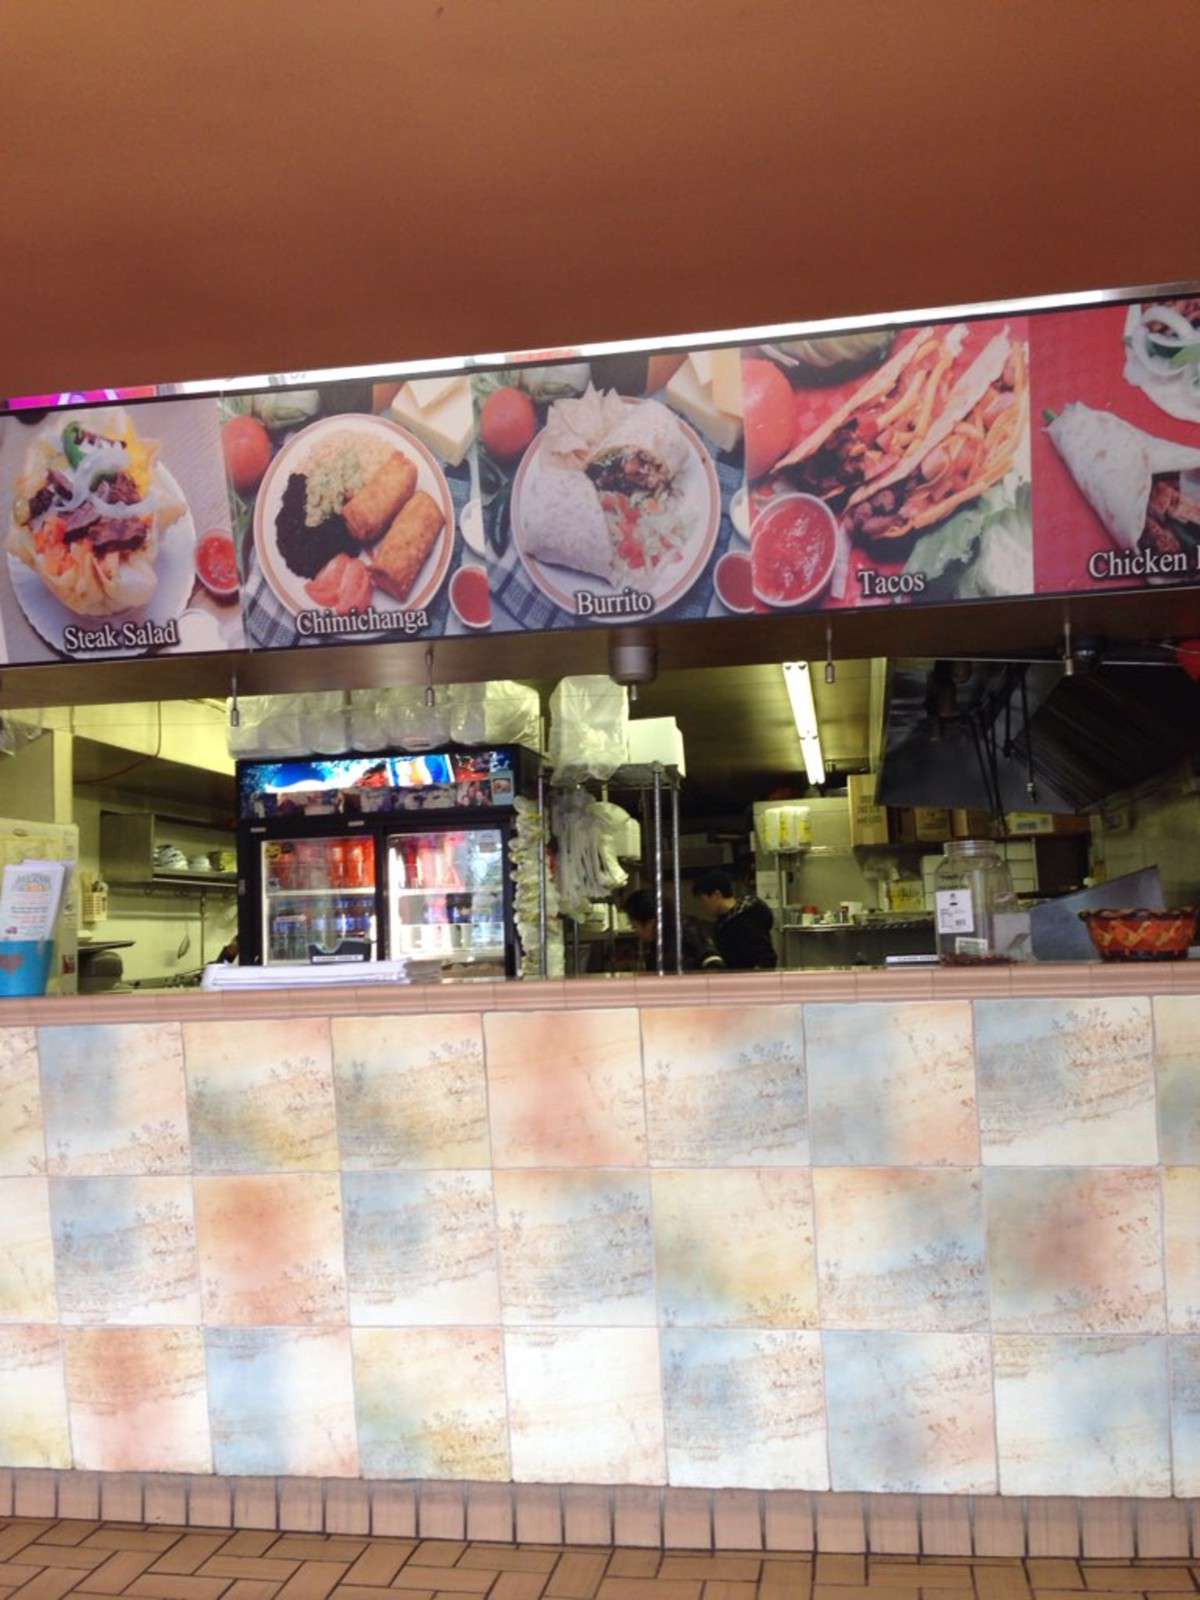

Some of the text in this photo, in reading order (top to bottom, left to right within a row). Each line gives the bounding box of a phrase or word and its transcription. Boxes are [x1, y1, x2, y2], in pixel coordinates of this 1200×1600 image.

[1088, 548, 1188, 578] Chicken
[858, 571, 925, 595] Tacos
[576, 588, 652, 615] Burrito
[64, 620, 177, 650] Steak Salad
[296, 607, 429, 635] Chimichanga
